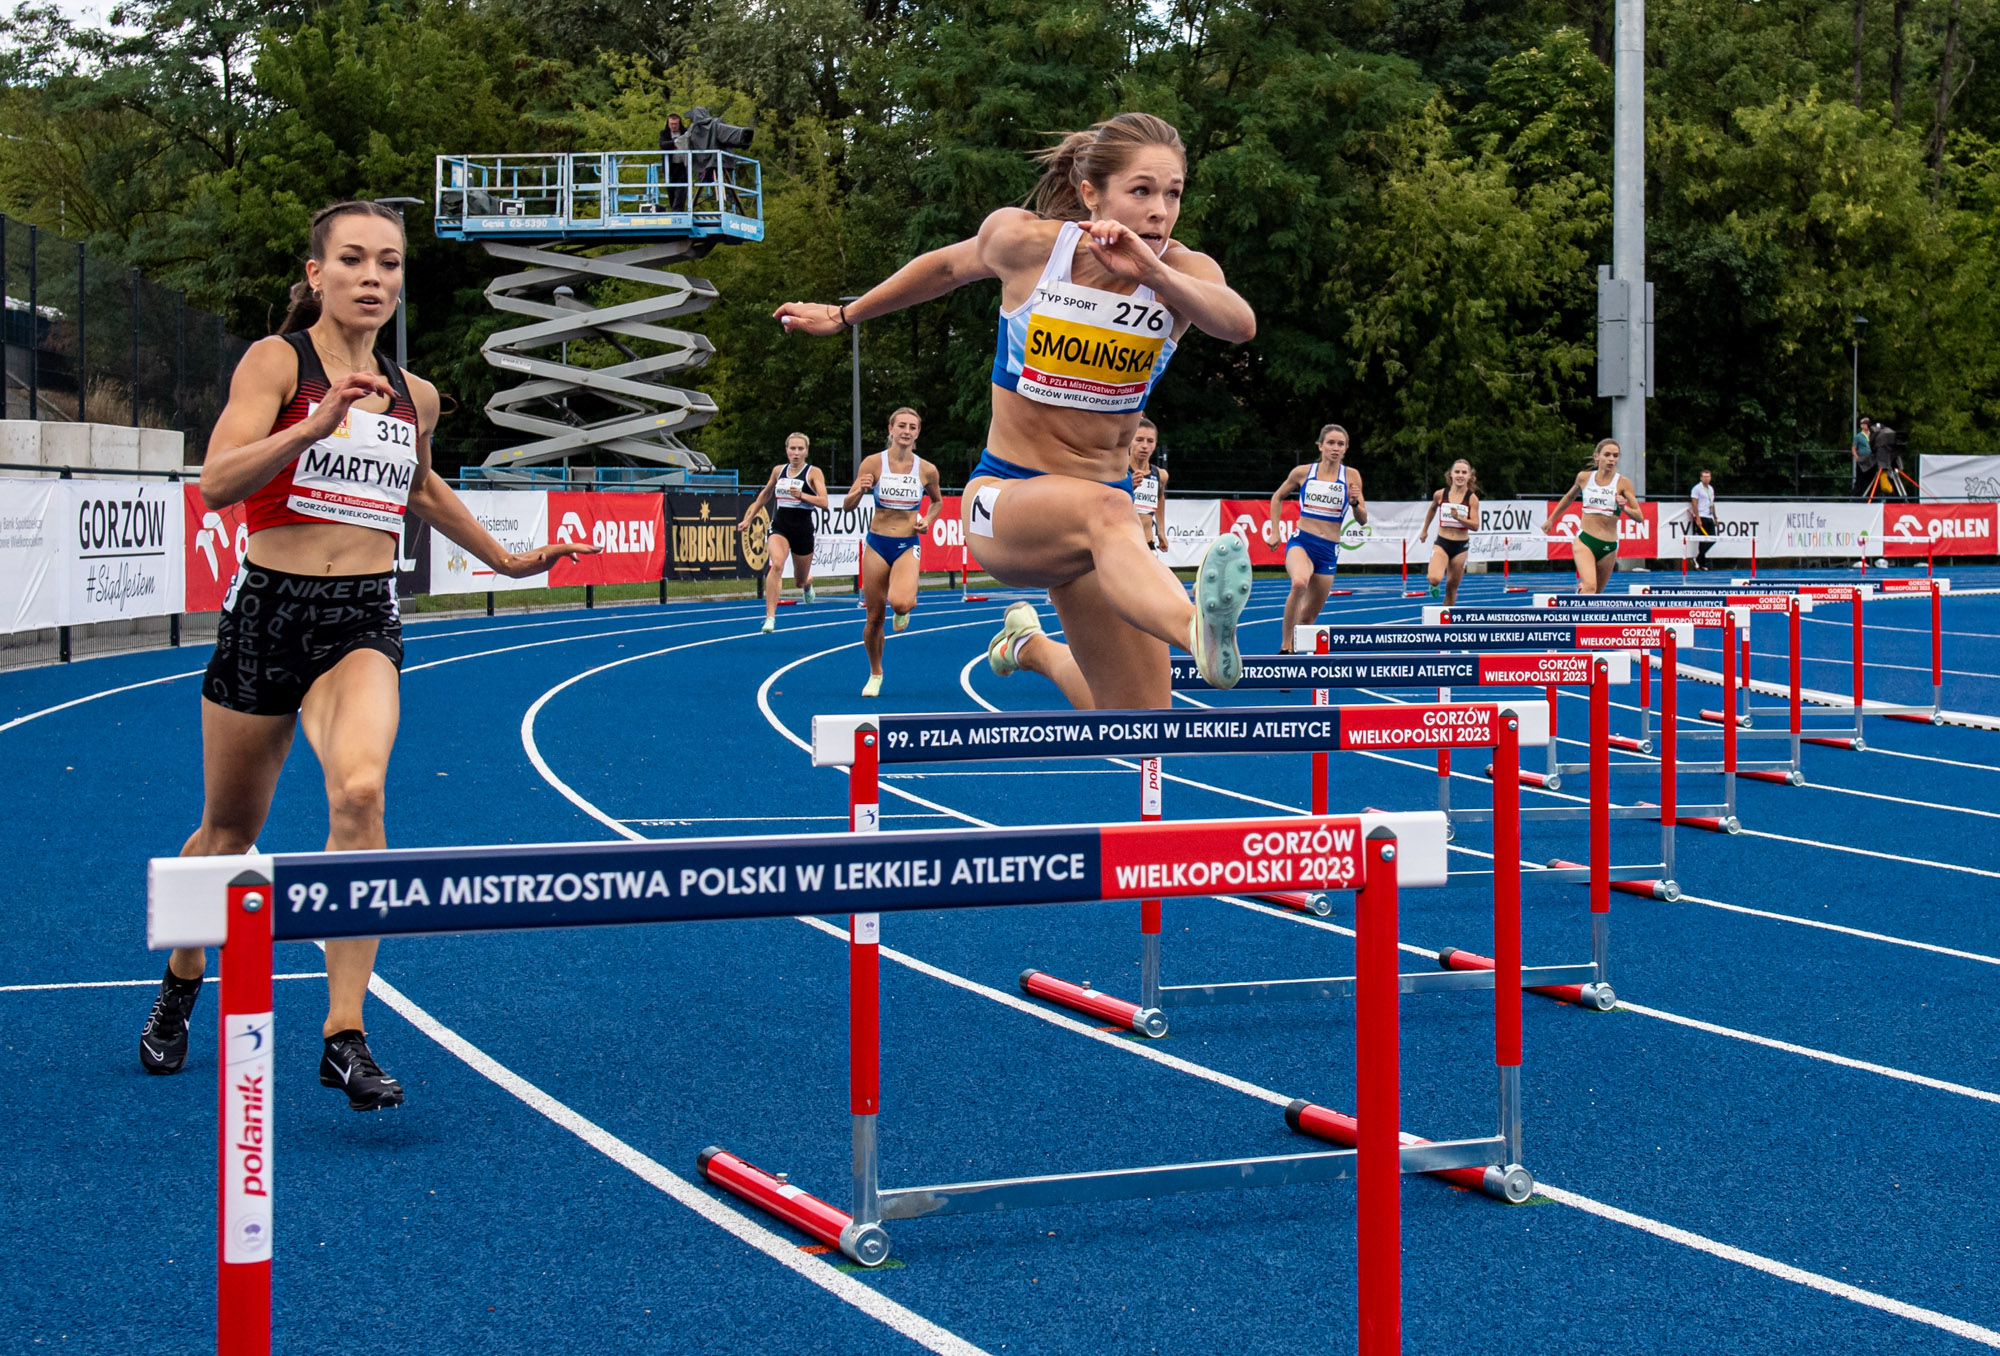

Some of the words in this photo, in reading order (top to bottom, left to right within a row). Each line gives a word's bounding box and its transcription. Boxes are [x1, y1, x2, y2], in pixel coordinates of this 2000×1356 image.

[482, 218, 505, 228] Genie
[1041, 291, 1061, 304] TVP
[1064, 297, 1098, 312] SPORT
[1113, 302, 1164, 331] 276
[1030, 329, 1154, 373] SMOLIŃSKA
[1036, 374, 1048, 385] 99.
[1049, 378, 1068, 388] PZLA
[1069, 381, 1116, 395] Mistrzostwa
[1117, 386, 1135, 395] Polski
[1023, 383, 1062, 399] GORZÓW
[1063, 393, 1123, 406] WIELKOPOLSKI
[377, 420, 410, 447] 312
[304, 448, 410, 490] MARTYNA
[881, 487, 918, 497] WOSZTYL
[1329, 484, 1342, 492] 465
[324, 493, 343, 503] PZLA
[1134, 492, 1157, 503] KIEWICZ
[1306, 493, 1342, 505] KORZUCH
[79, 487, 165, 550] GORZÓW
[296, 500, 336, 514] GORZÓW
[338, 509, 392, 523] WIELKOPOLSKI
[1481, 504, 1532, 530] RZÓW
[1786, 511, 1814, 528] NESTLÉ
[1816, 516, 1827, 528] for
[476, 515, 518, 532] inisterstwo
[933, 519, 966, 546] ORL
[1262, 520, 1298, 543] ORL
[1617, 519, 1650, 539] LEN
[1669, 521, 1691, 539] TV
[1717, 521, 1759, 537] PORT
[1928, 518, 1989, 539] ORLEN
[593, 520, 655, 554] ORLEN
[1787, 532, 1832, 547] HEALTHIER
[1836, 532, 1855, 547] KIDS
[276, 578, 353, 600] NIKE
[1759, 596, 1787, 604] GORZÓW
[1452, 613, 1464, 622] 99.
[1466, 613, 1485, 622] PZLA
[1487, 613, 1541, 622] MISTRZOSTWA
[1543, 613, 1570, 622] POLSKI
[1571, 613, 1580, 622] W
[1581, 613, 1610, 622] LEKKIEJ
[1611, 613, 1647, 622] ATLETYCE
[1689, 609, 1722, 618] GORZÓW
[1705, 618, 1721, 626] 2023
[1333, 634, 1347, 644] 99.
[1350, 634, 1373, 644] PZLA
[1375, 633, 1441, 643] MISTRZOSTWA
[1444, 632, 1476, 643] POLSKI
[1478, 632, 1489, 642] W
[1490, 632, 1524, 642] LEKKIEJ
[1527, 632, 1570, 642] ATLETYCE
[1622, 626, 1660, 637] GORZÓW
[1580, 637, 1639, 646] WIELKOPOLSKI
[1641, 637, 1660, 647] 2023
[1189, 667, 1203, 679] PZ
[1311, 665, 1352, 678] POLSKI
[1355, 666, 1368, 678] W
[1370, 665, 1415, 678] LEKKIEJ
[1417, 664, 1472, 677] ATLETYCE
[1538, 656, 1587, 670] GORZÓW
[1485, 671, 1560, 682] WIELKOPOLSKI
[1562, 671, 1587, 682] 2023
[1423, 707, 1490, 726] GORZÓW
[887, 731, 914, 749] 99.
[920, 729, 963, 747] PZLA
[968, 725, 1093, 745] MISTRZOSTWA
[1099, 722, 1158, 741] POLSKI
[1163, 723, 1180, 739] W
[1185, 721, 1248, 739] LEKKIEJ
[1252, 721, 1331, 738] ATLETYCE
[1349, 728, 1453, 745] WIELKOPOLSKI
[1456, 727, 1491, 743] 2023
[1243, 824, 1356, 856] GORZÓW
[1116, 859, 1292, 890] WIELKOPOLSKI
[1298, 857, 1355, 882] 2023
[287, 882, 338, 913] 99.
[350, 878, 430, 910] PZLA
[440, 870, 670, 906] MISTRZOSTWA
[681, 866, 786, 897] POLSKI
[796, 864, 826, 891] W
[834, 859, 942, 891] LEKKIEJ
[951, 853, 1085, 885] ATLETYCE
[236, 1074, 268, 1197] polanik
